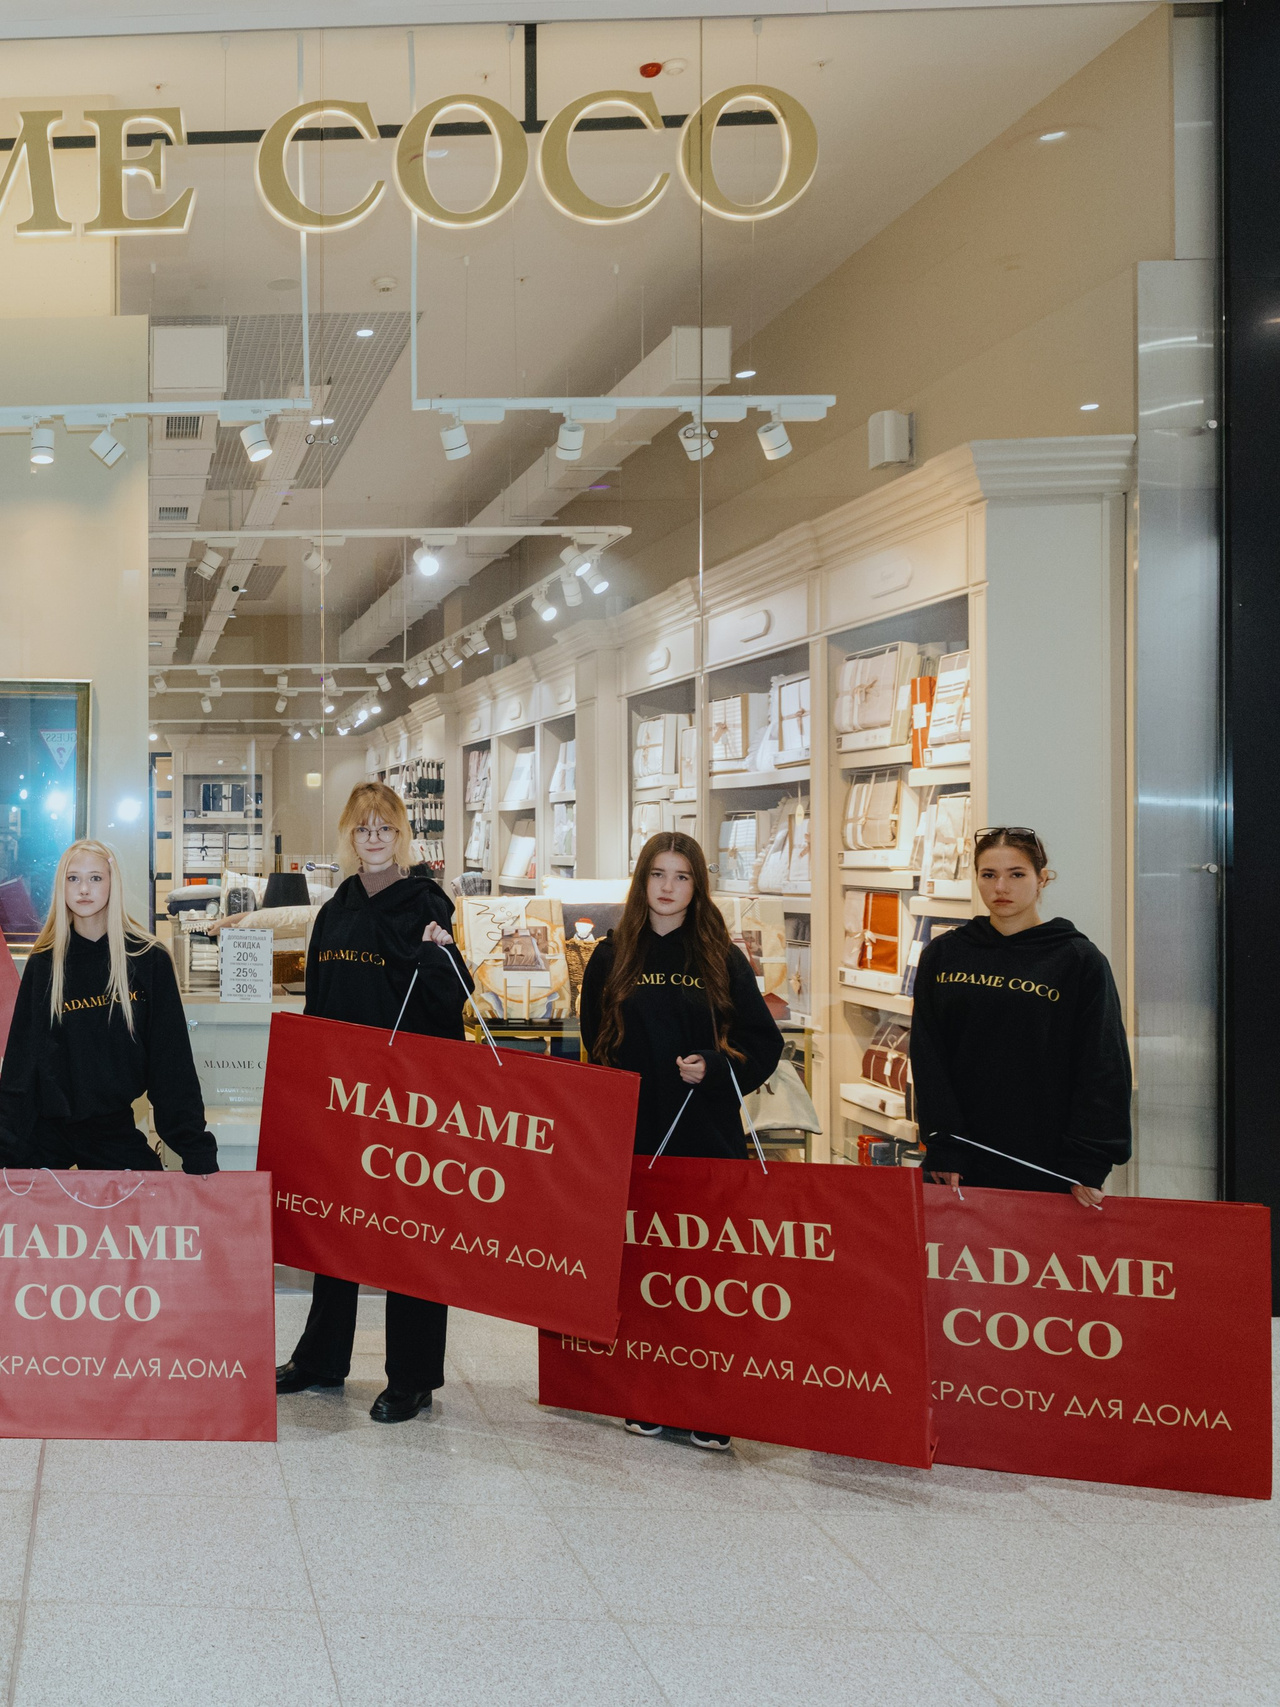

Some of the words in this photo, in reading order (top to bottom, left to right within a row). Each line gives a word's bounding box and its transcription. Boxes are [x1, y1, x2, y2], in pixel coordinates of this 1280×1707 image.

[255, 84, 819, 234] COCO
[233, 941, 261, 949] СКИДКА
[233, 952, 258, 962] -20%
[232, 968, 258, 978] -25%
[670, 973, 705, 989] COC
[61, 994, 111, 1013] ADAME
[232, 984, 257, 994] -30%
[1008, 978, 1060, 1002] COCO
[204, 1060, 254, 1069] MADAME
[325, 1076, 554, 1154] MADAME
[361, 1144, 505, 1203] COCO
[277, 1191, 333, 1218] НЕСУ
[340, 1205, 445, 1244] КРАСОТУ
[451, 1233, 499, 1258] ДЛЯ
[506, 1245, 586, 1279] ДОМА
[15, 1284, 160, 1321] COCO
[641, 1272, 791, 1321] COCO
[943, 1308, 1122, 1359] COCO
[114, 1358, 160, 1379] ДЛЯ
[169, 1359, 246, 1380] ДОМА
[627, 1340, 734, 1372] КРАСОТУ
[743, 1357, 793, 1380] ДЛЯ
[803, 1364, 891, 1394] ДОМА
[1064, 1396, 1122, 1419] ДЛЯ
[1133, 1403, 1231, 1430] ДОМА
